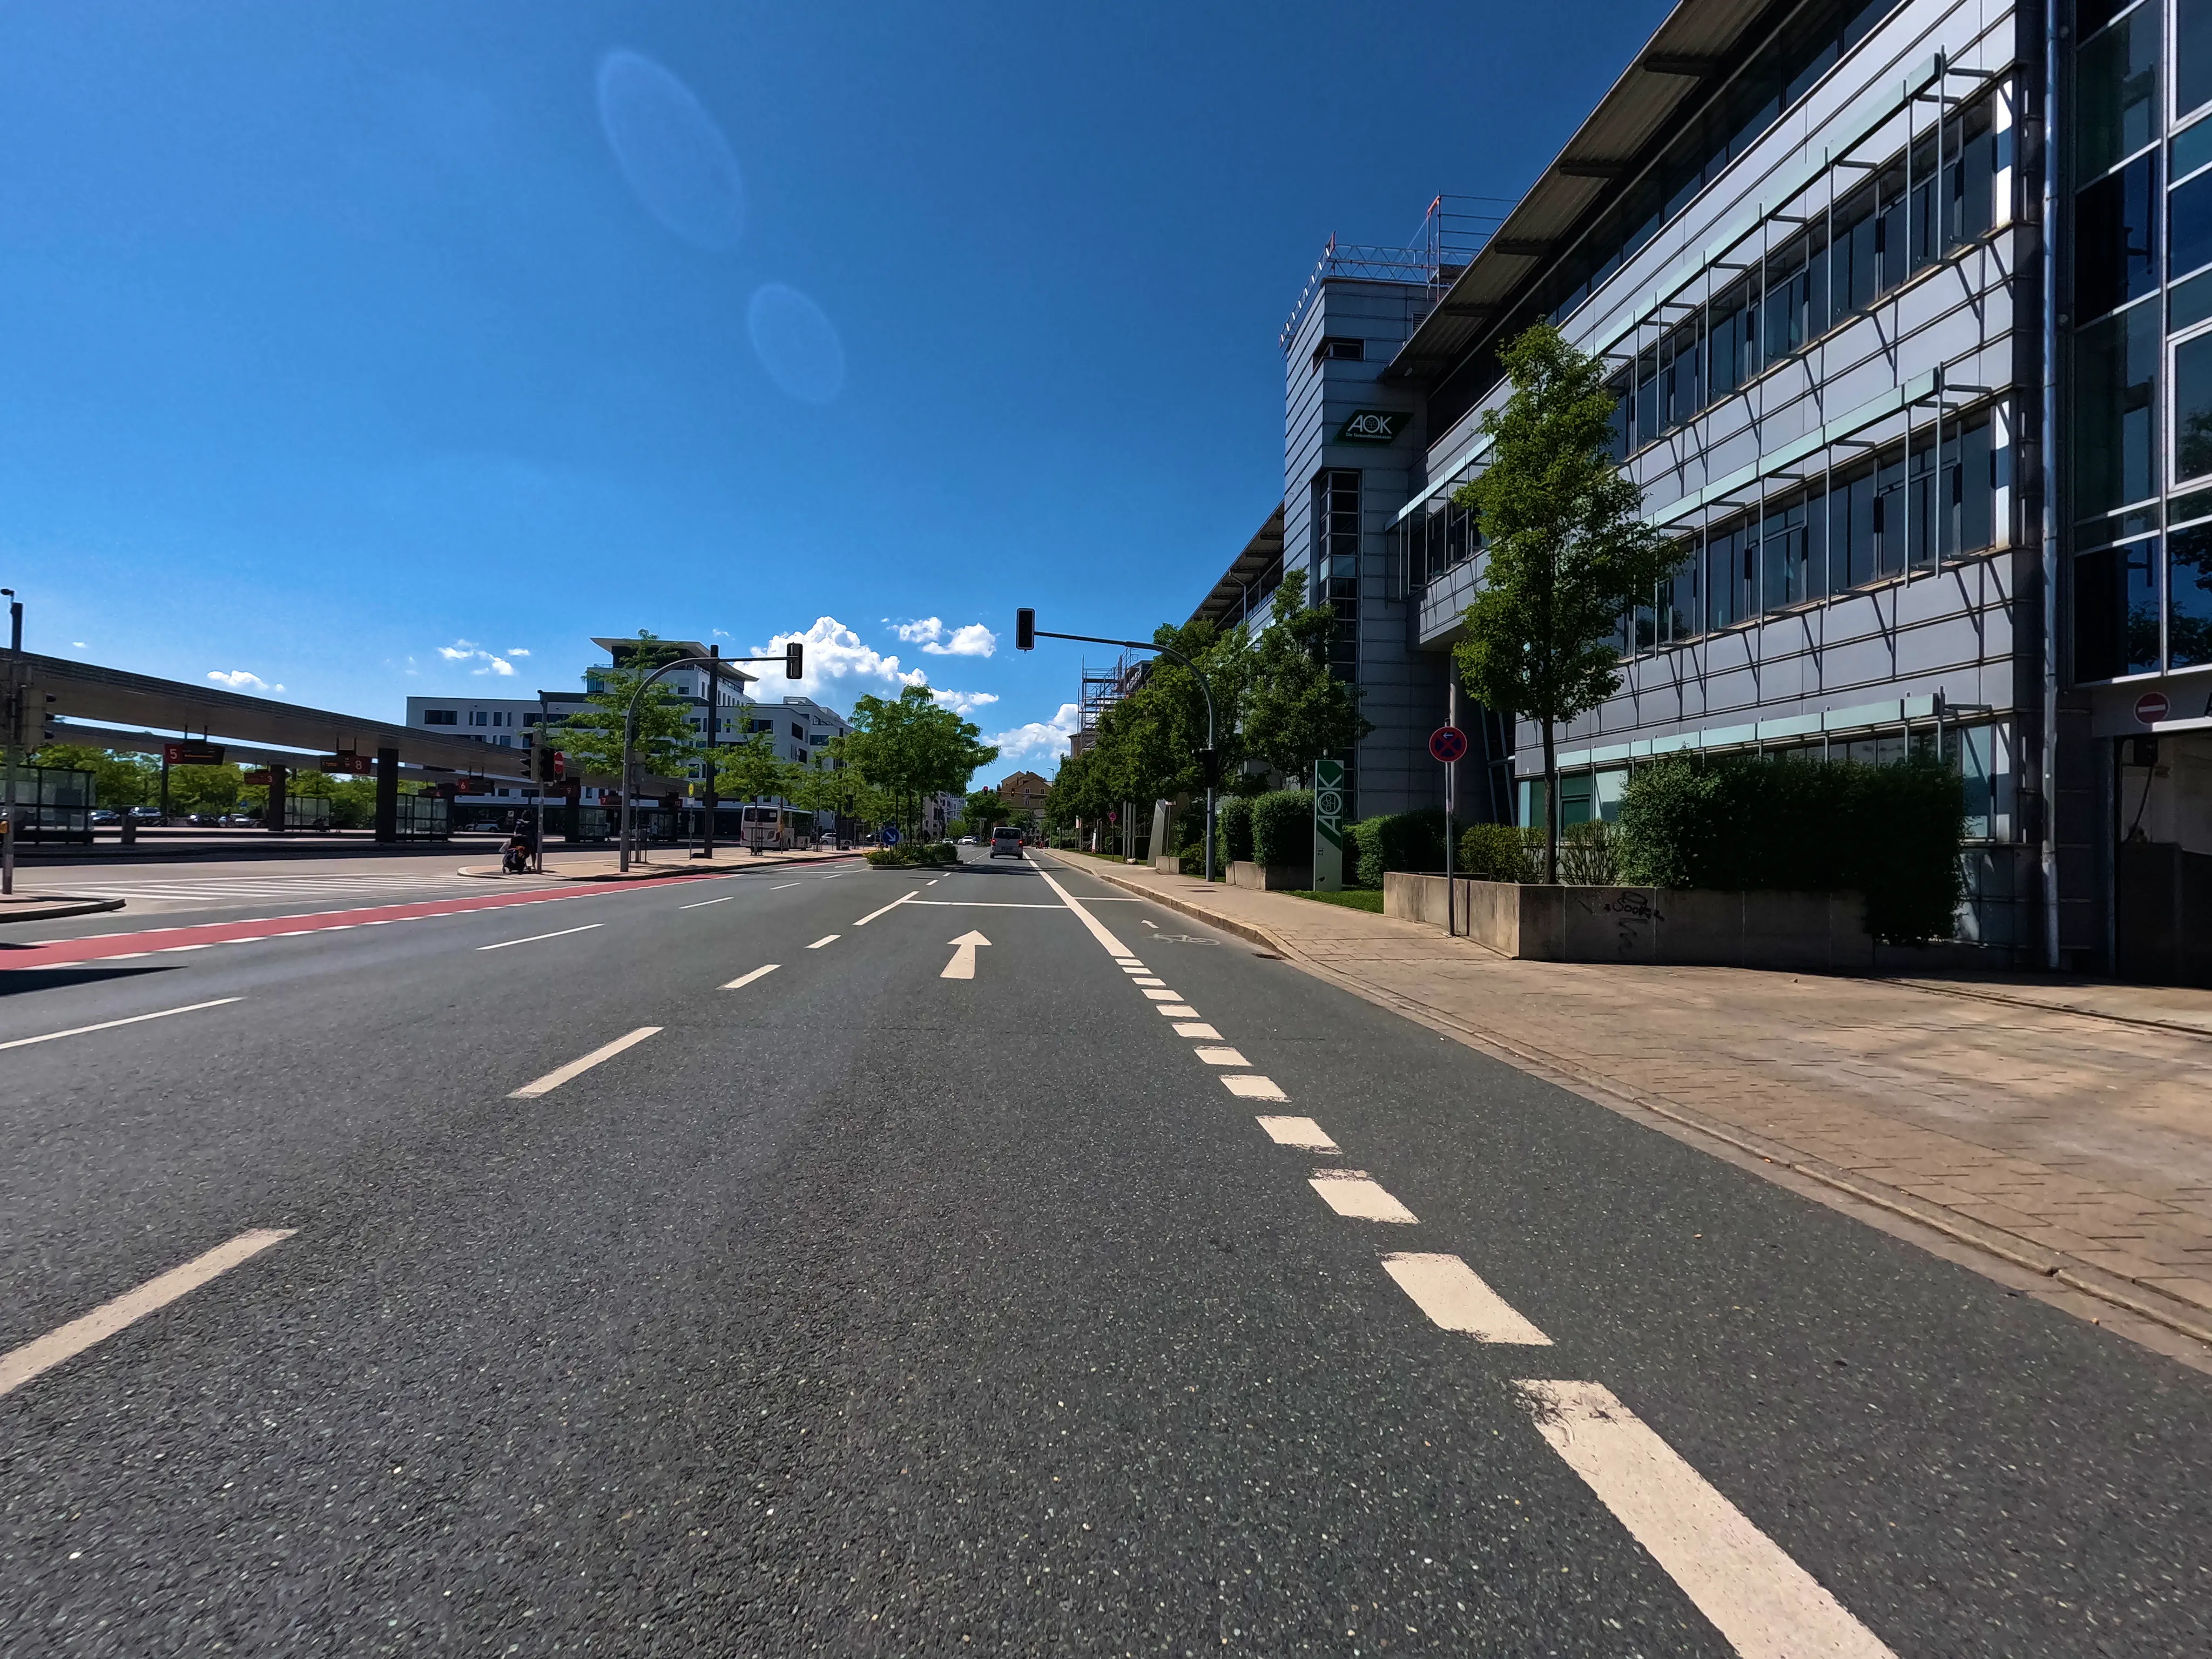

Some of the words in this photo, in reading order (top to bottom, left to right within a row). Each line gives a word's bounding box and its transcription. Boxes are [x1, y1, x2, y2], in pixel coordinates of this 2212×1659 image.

[1347, 415, 1393, 434] AOK
[170, 748, 178, 759] 5
[355, 760, 362, 770] 8
[1318, 773, 1342, 837] AOK
